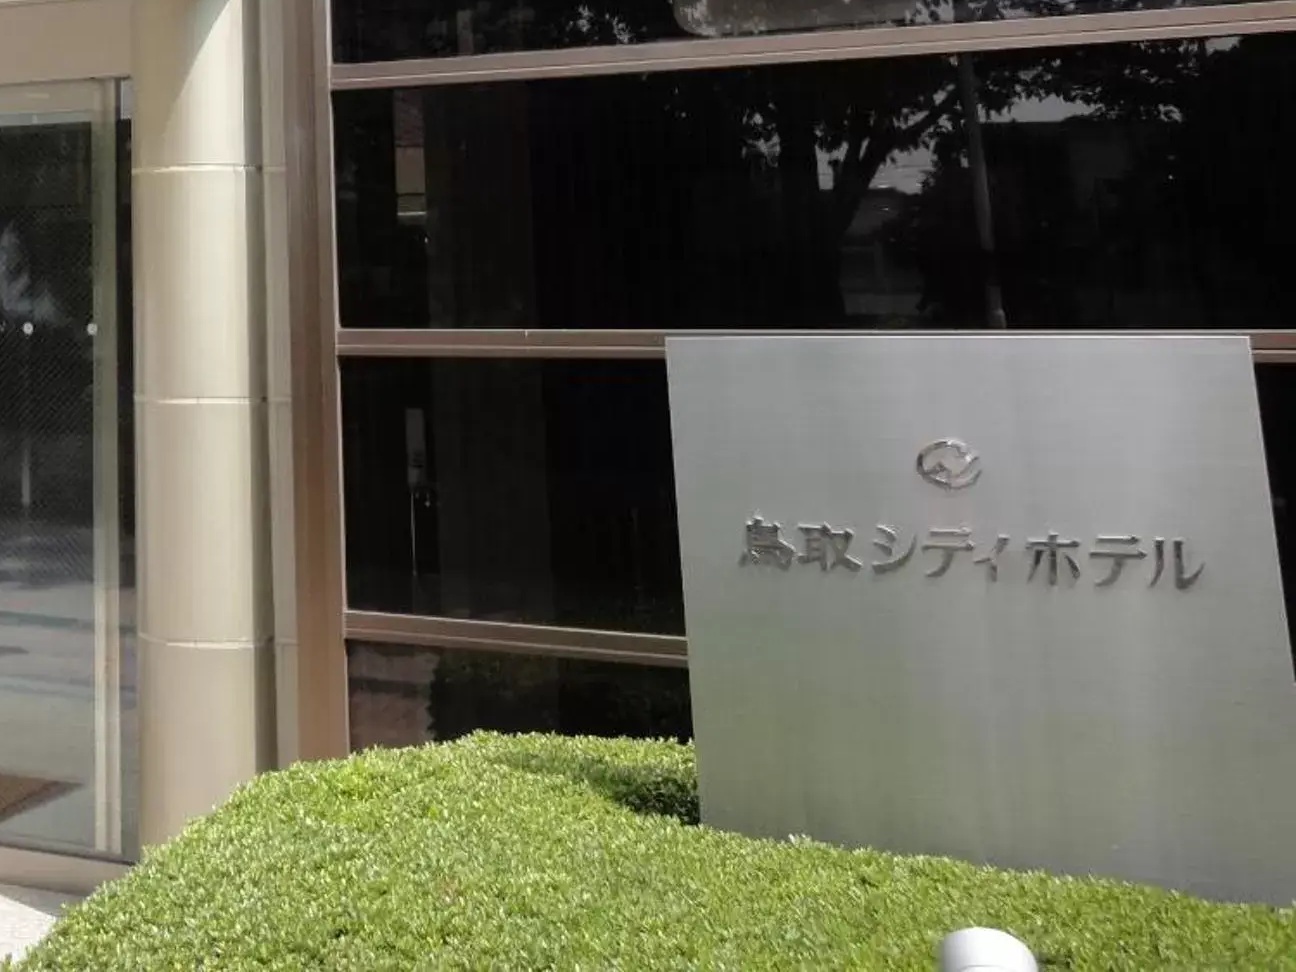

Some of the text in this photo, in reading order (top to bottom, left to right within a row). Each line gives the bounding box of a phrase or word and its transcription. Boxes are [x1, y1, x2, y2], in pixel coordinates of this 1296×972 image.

[739, 512, 1205, 591] 鳥取シティホテル
